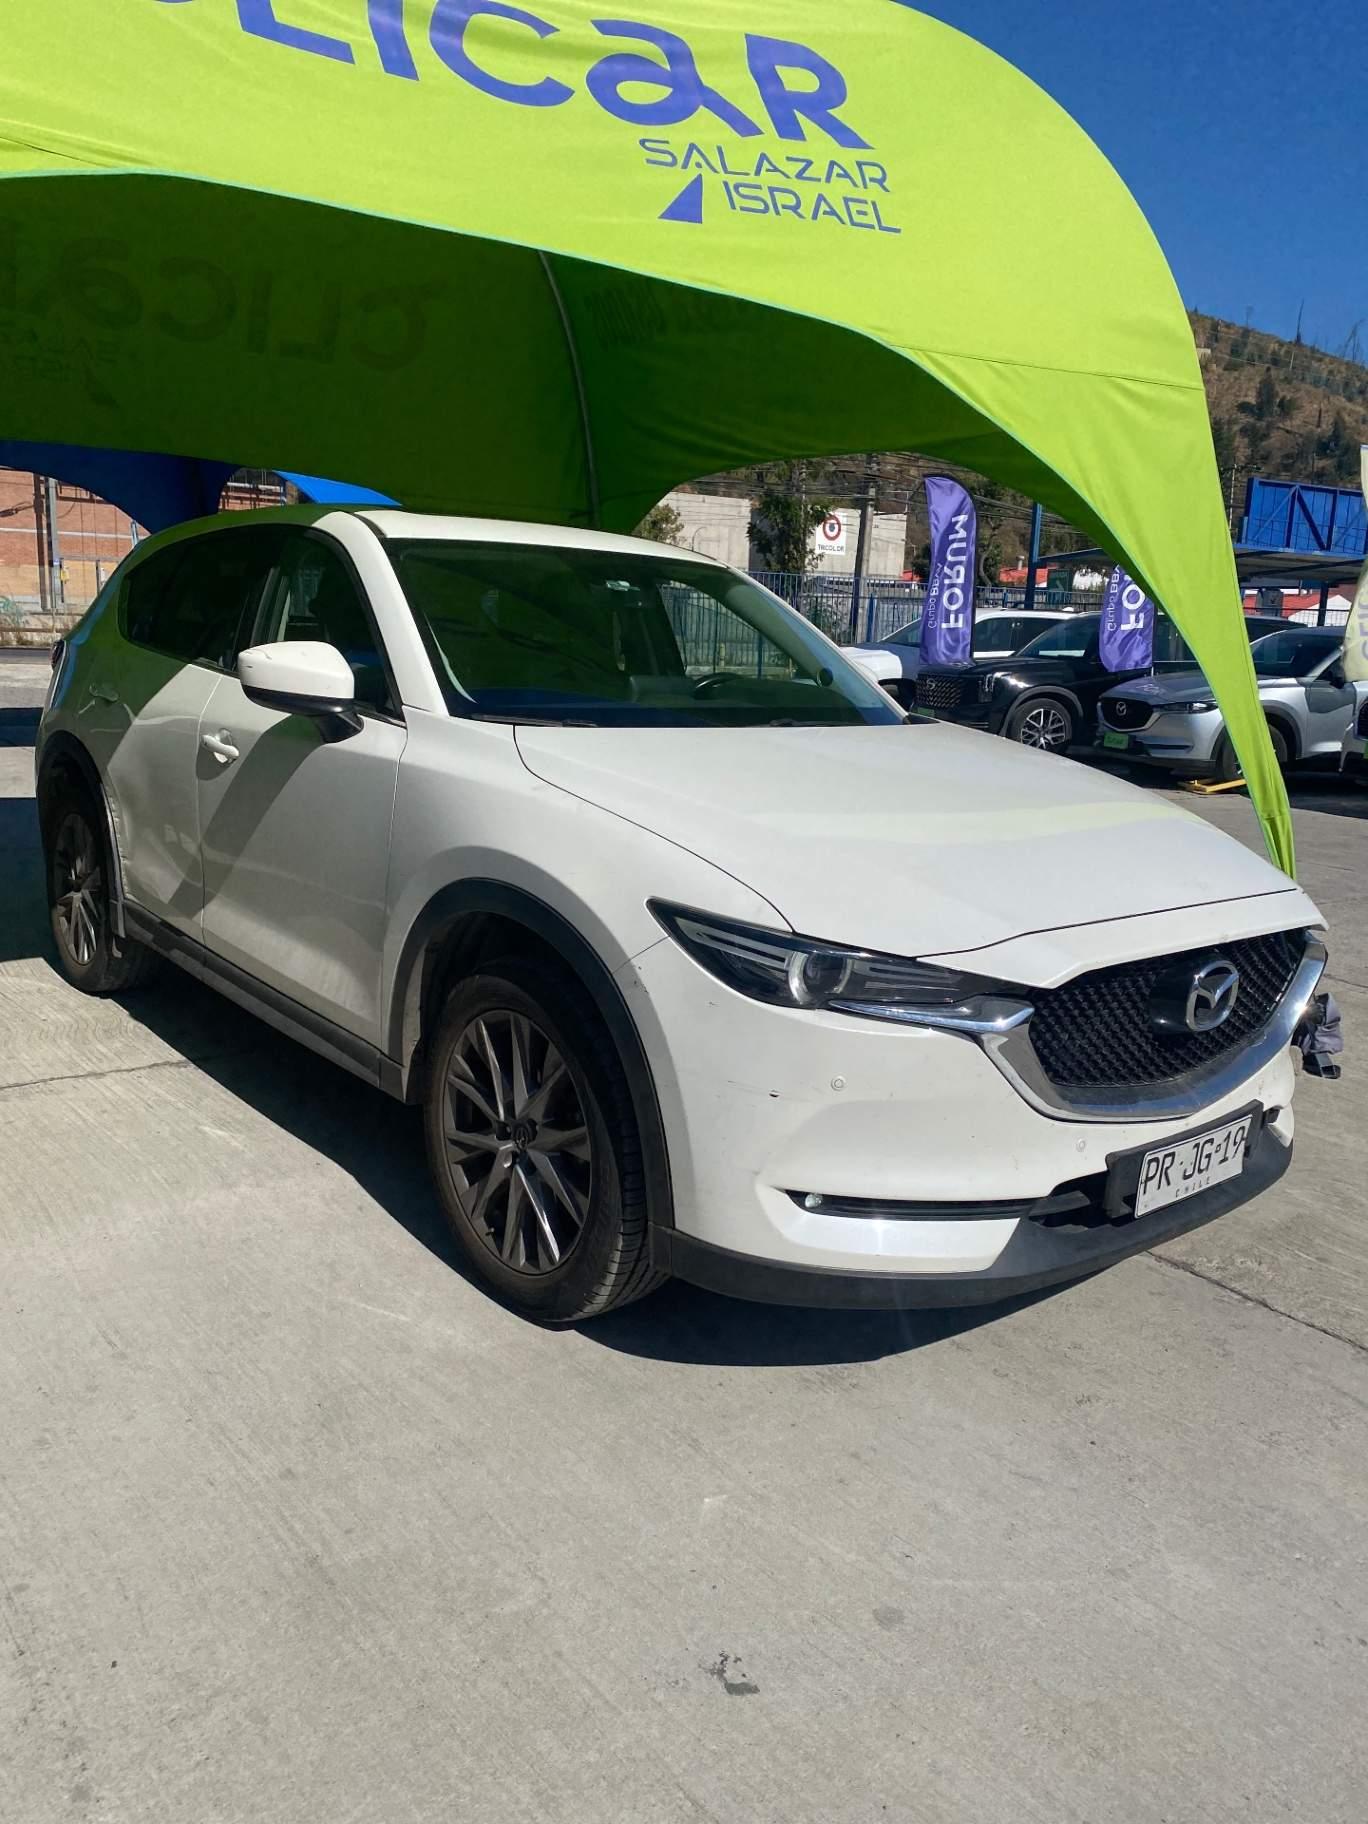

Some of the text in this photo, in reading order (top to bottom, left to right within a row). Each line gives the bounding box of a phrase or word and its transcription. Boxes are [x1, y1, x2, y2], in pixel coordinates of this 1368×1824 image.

[638, 138, 891, 193] SALAZAR
[722, 180, 902, 233] ISRAEL
[817, 544, 845, 552] TRICOLOR
